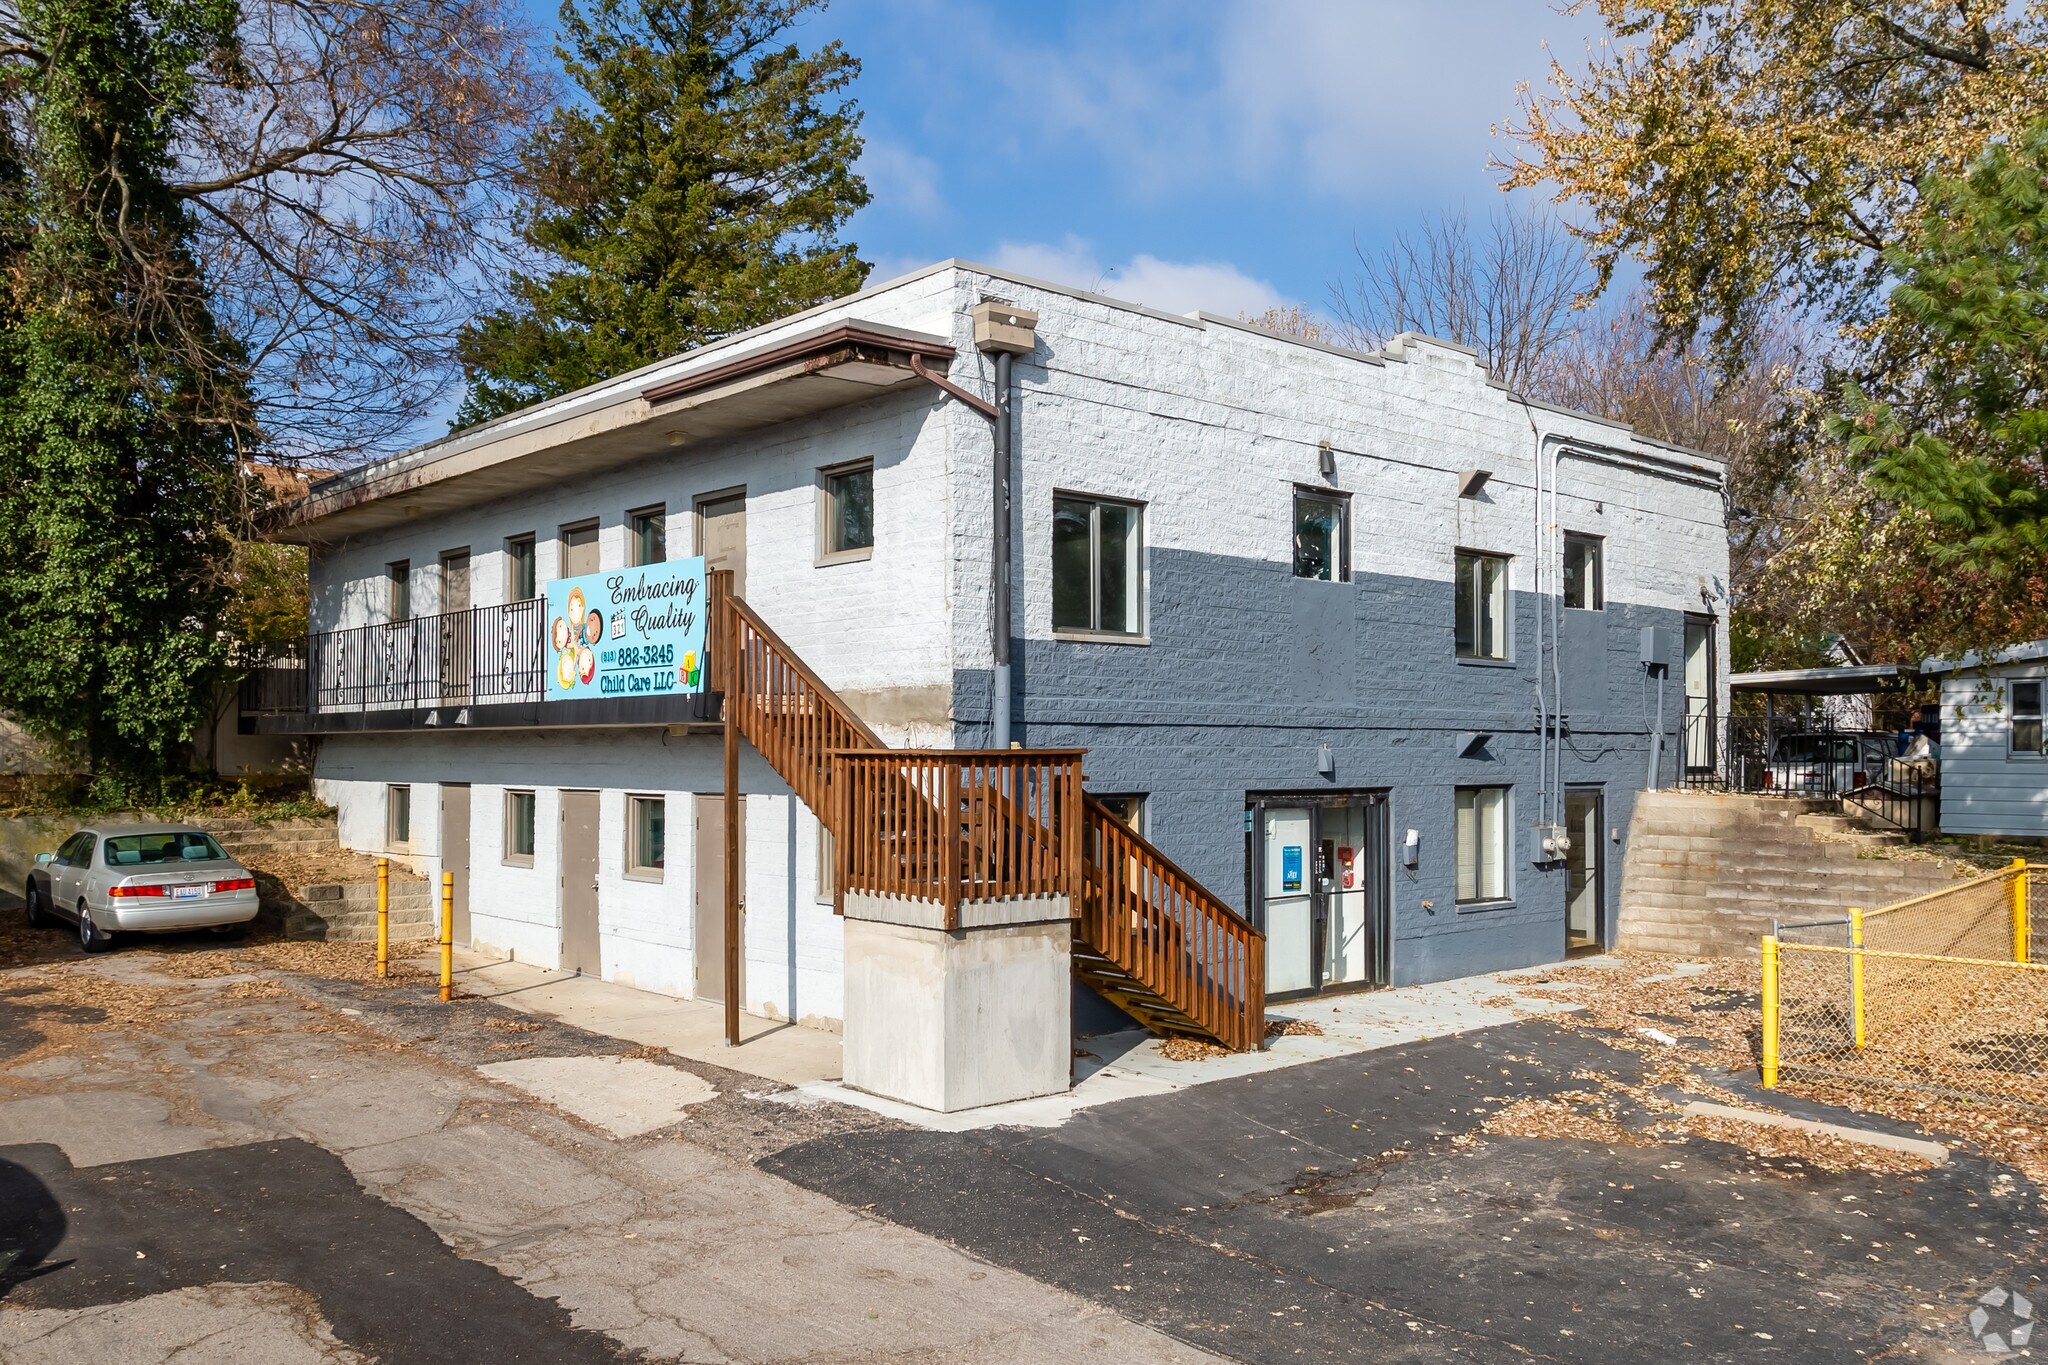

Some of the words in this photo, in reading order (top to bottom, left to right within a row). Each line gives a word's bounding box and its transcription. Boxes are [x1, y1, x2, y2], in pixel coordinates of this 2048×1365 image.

[606, 572, 697, 606] Embracing
[631, 602, 696, 640] Quality
[618, 644, 674, 667] 882-3245
[600, 675, 625, 694] Child
[627, 672, 650, 691] Care
[653, 671, 674, 690] LLC
